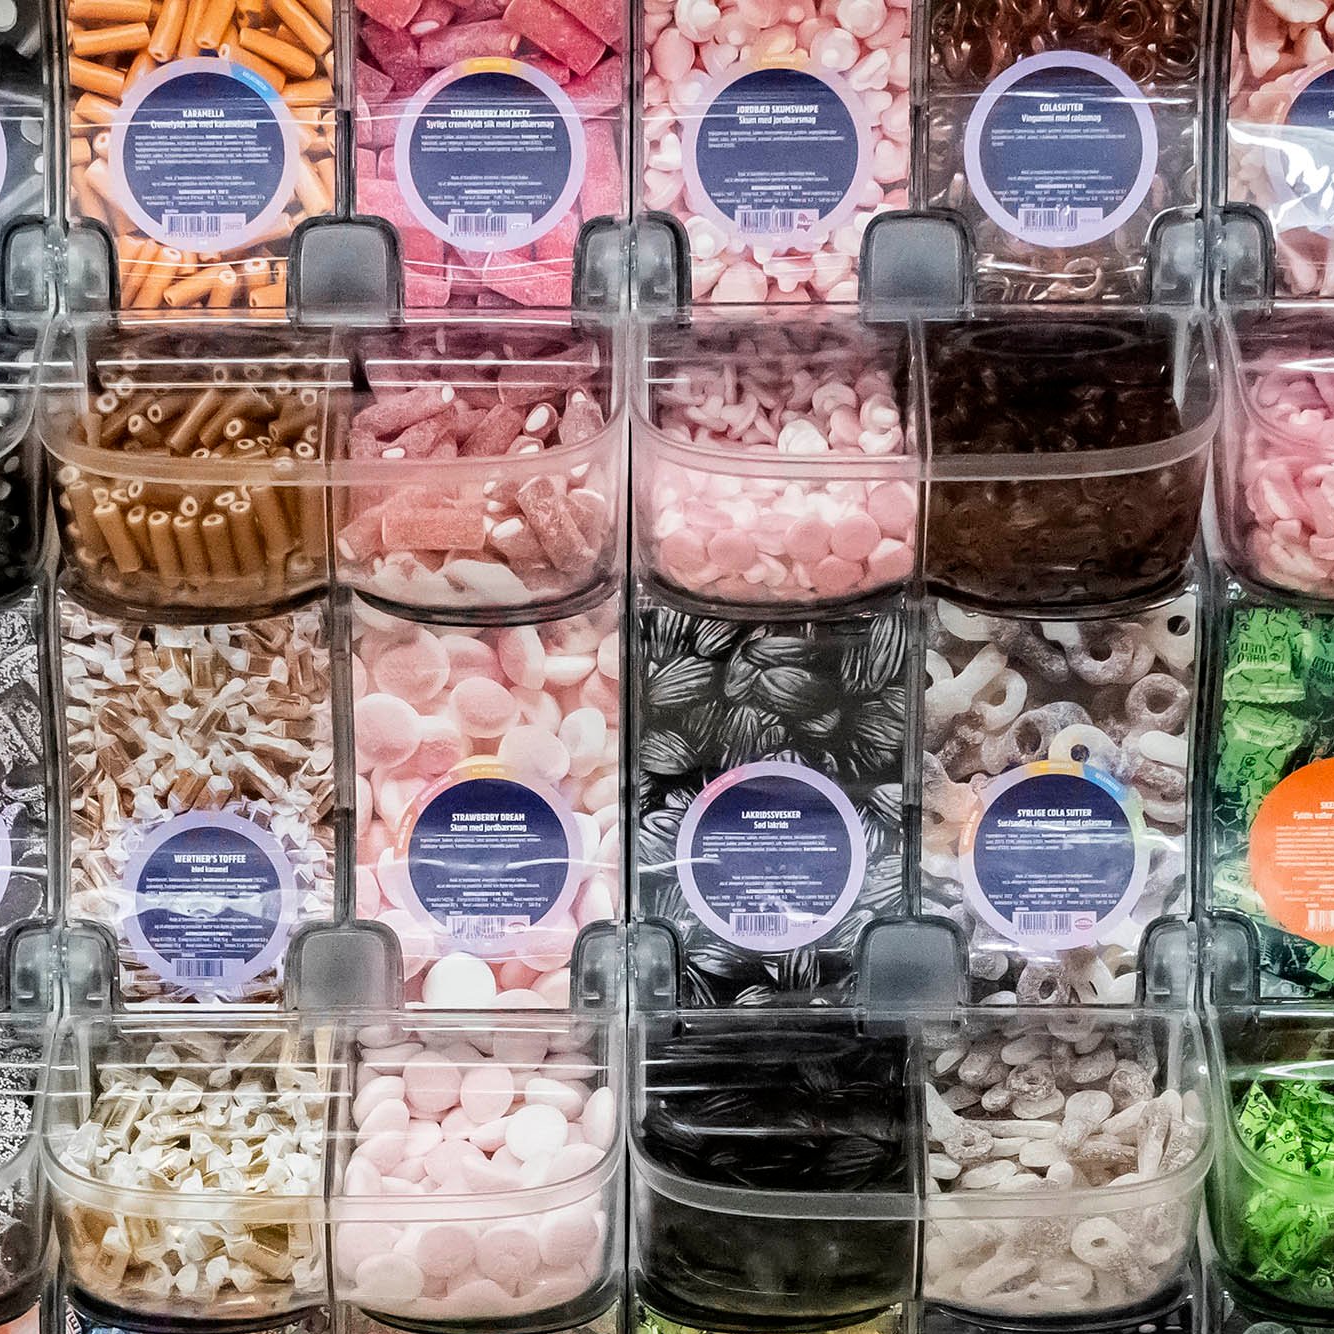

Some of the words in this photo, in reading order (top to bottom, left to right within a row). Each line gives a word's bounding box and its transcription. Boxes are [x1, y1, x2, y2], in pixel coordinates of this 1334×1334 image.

[737, 105, 770, 114] JORDBÆR
[772, 105, 818, 114] SKUMSVAMPE
[1040, 103, 1083, 112] COLASUTTER
[183, 109, 224, 118] KARAMELLA
[739, 116, 756, 124] Skum
[758, 116, 772, 124] med
[773, 116, 816, 125] jordbærsmag
[452, 813, 499, 822] STRAWBERRY
[501, 813, 525, 822] DREAM
[742, 811, 801, 819] LAKRIDSSVESKER
[1017, 809, 1045, 817] SYRLIGE
[1047, 809, 1065, 817] COLA
[1066, 809, 1091, 817] SUTTER
[451, 823, 468, 831] Skum
[469, 823, 483, 831] med
[485, 823, 527, 832] jordbærsmag
[175, 854, 217, 864] WERTHER'S
[219, 854, 245, 864] TOFFEE
